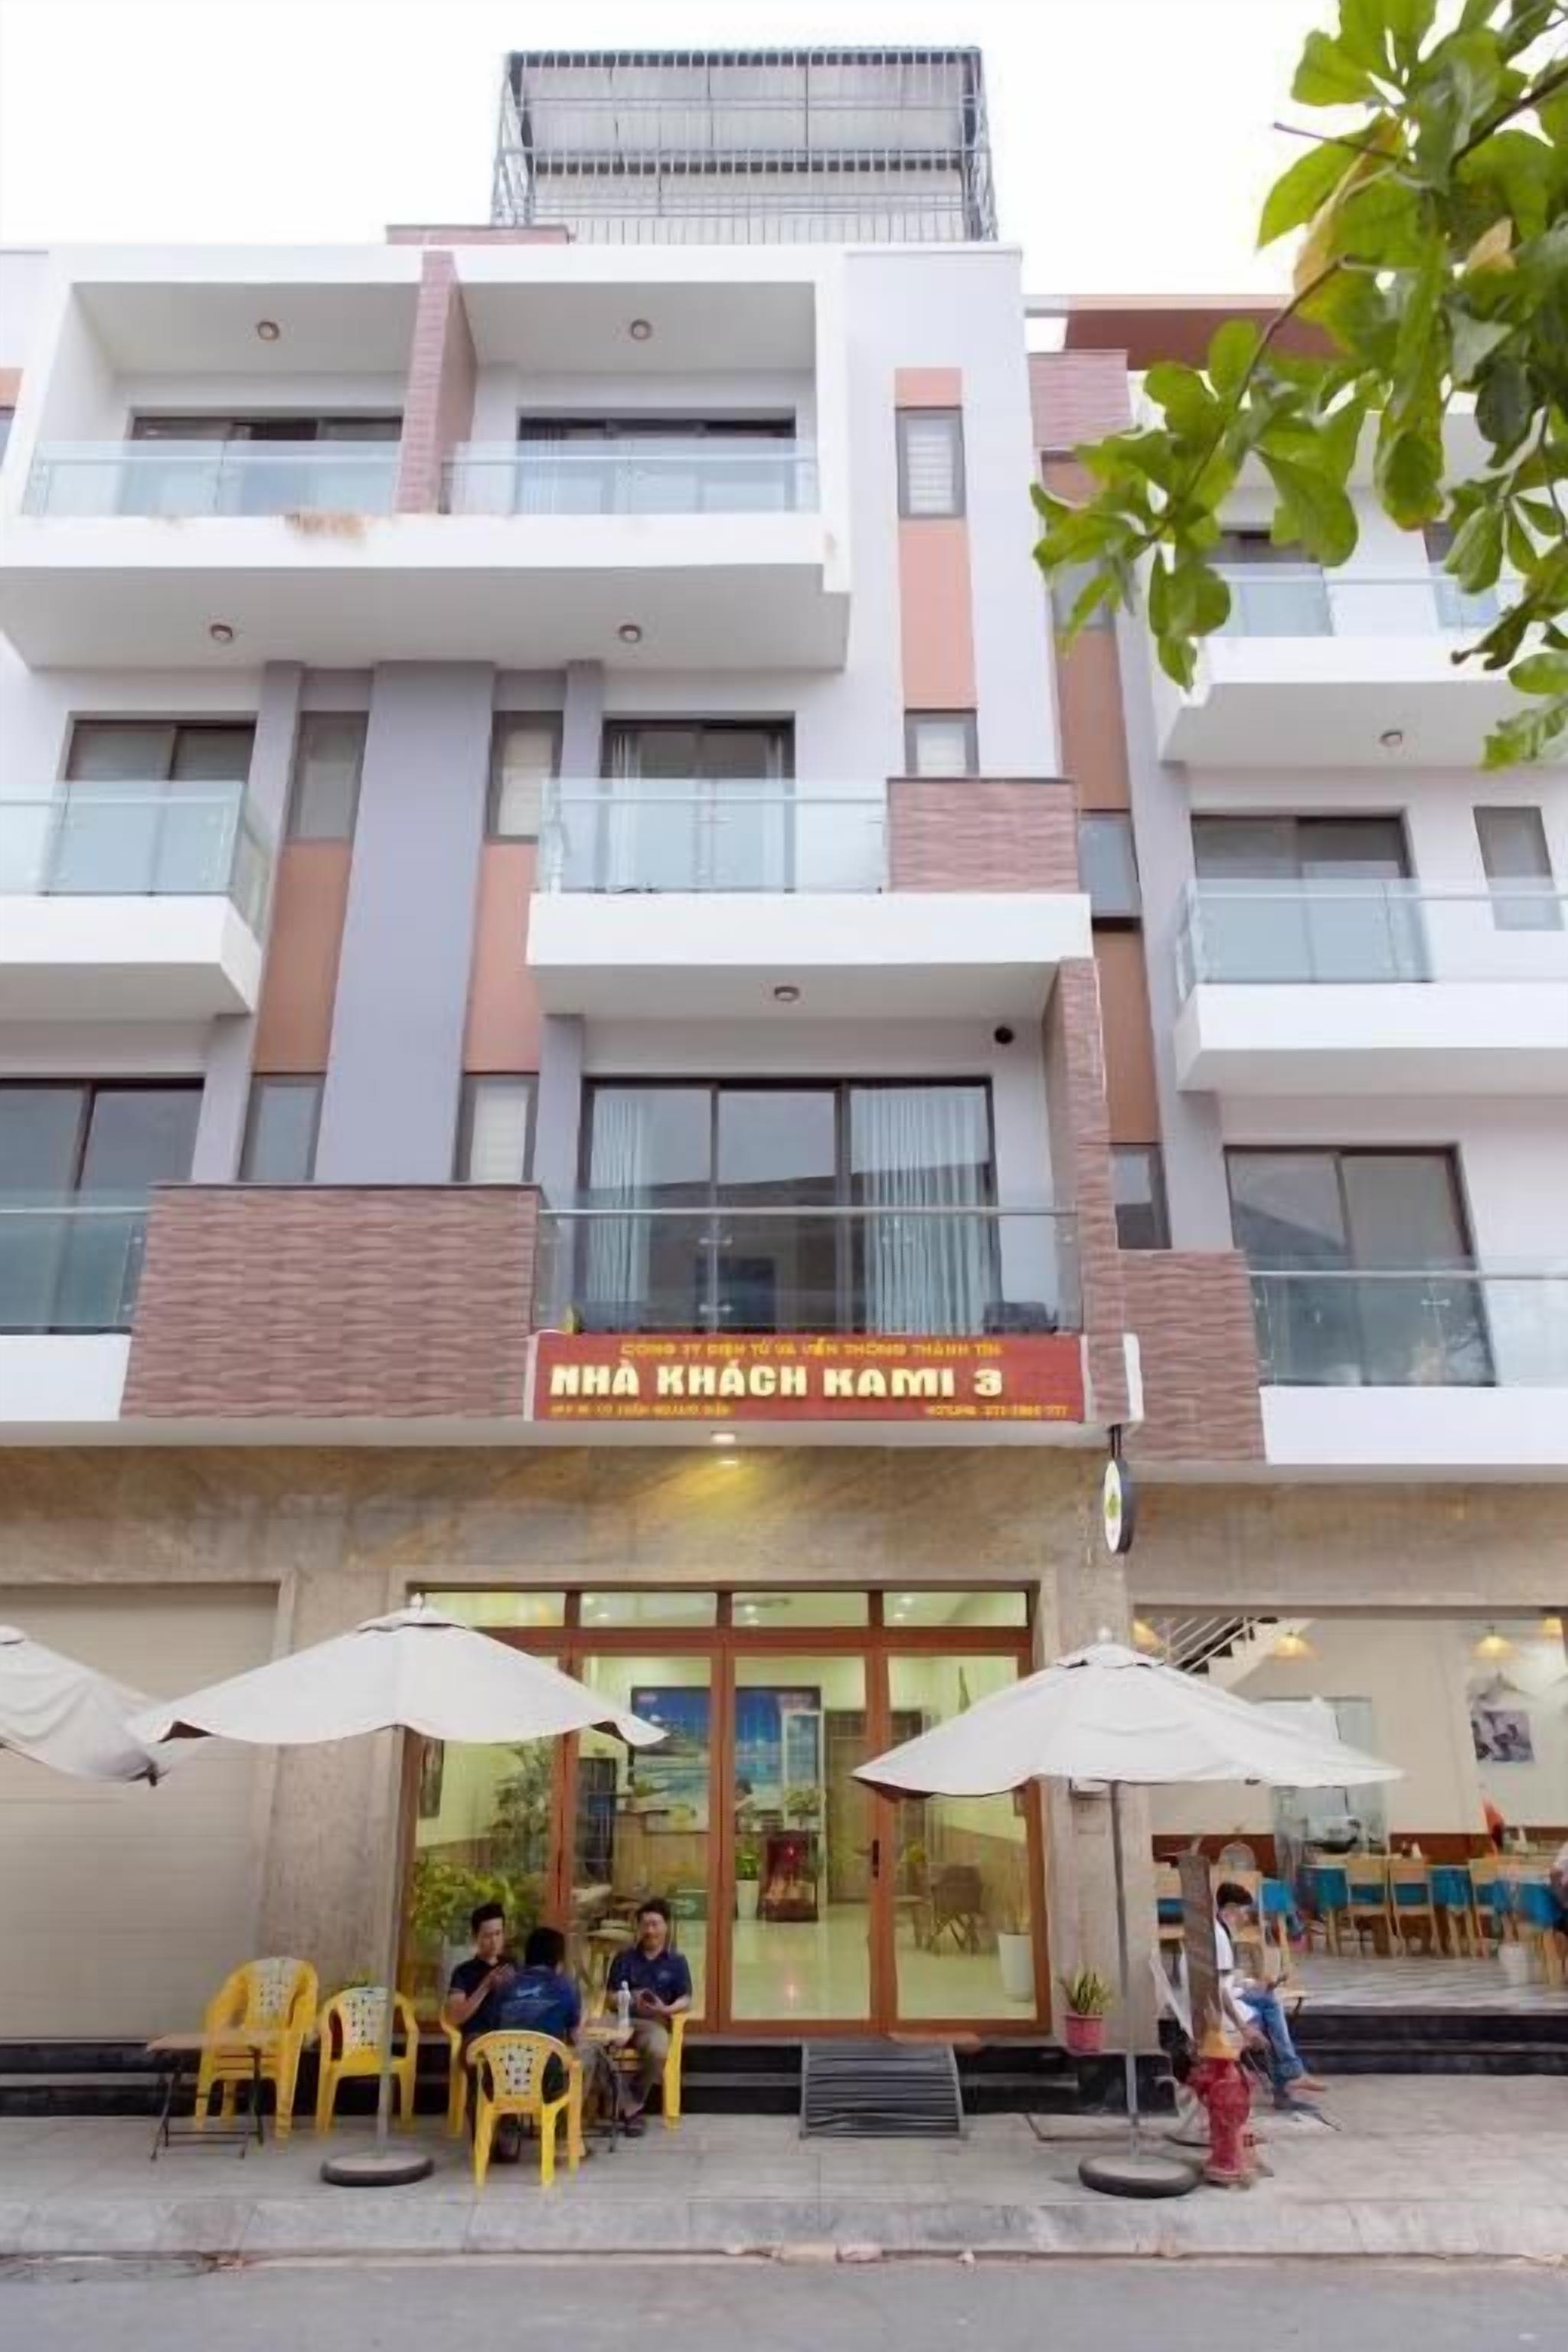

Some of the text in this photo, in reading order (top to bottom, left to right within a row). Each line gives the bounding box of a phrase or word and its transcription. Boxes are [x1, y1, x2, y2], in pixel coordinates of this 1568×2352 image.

[550, 1358, 1003, 1397] NHÀ KHÁCH KAMI 3
